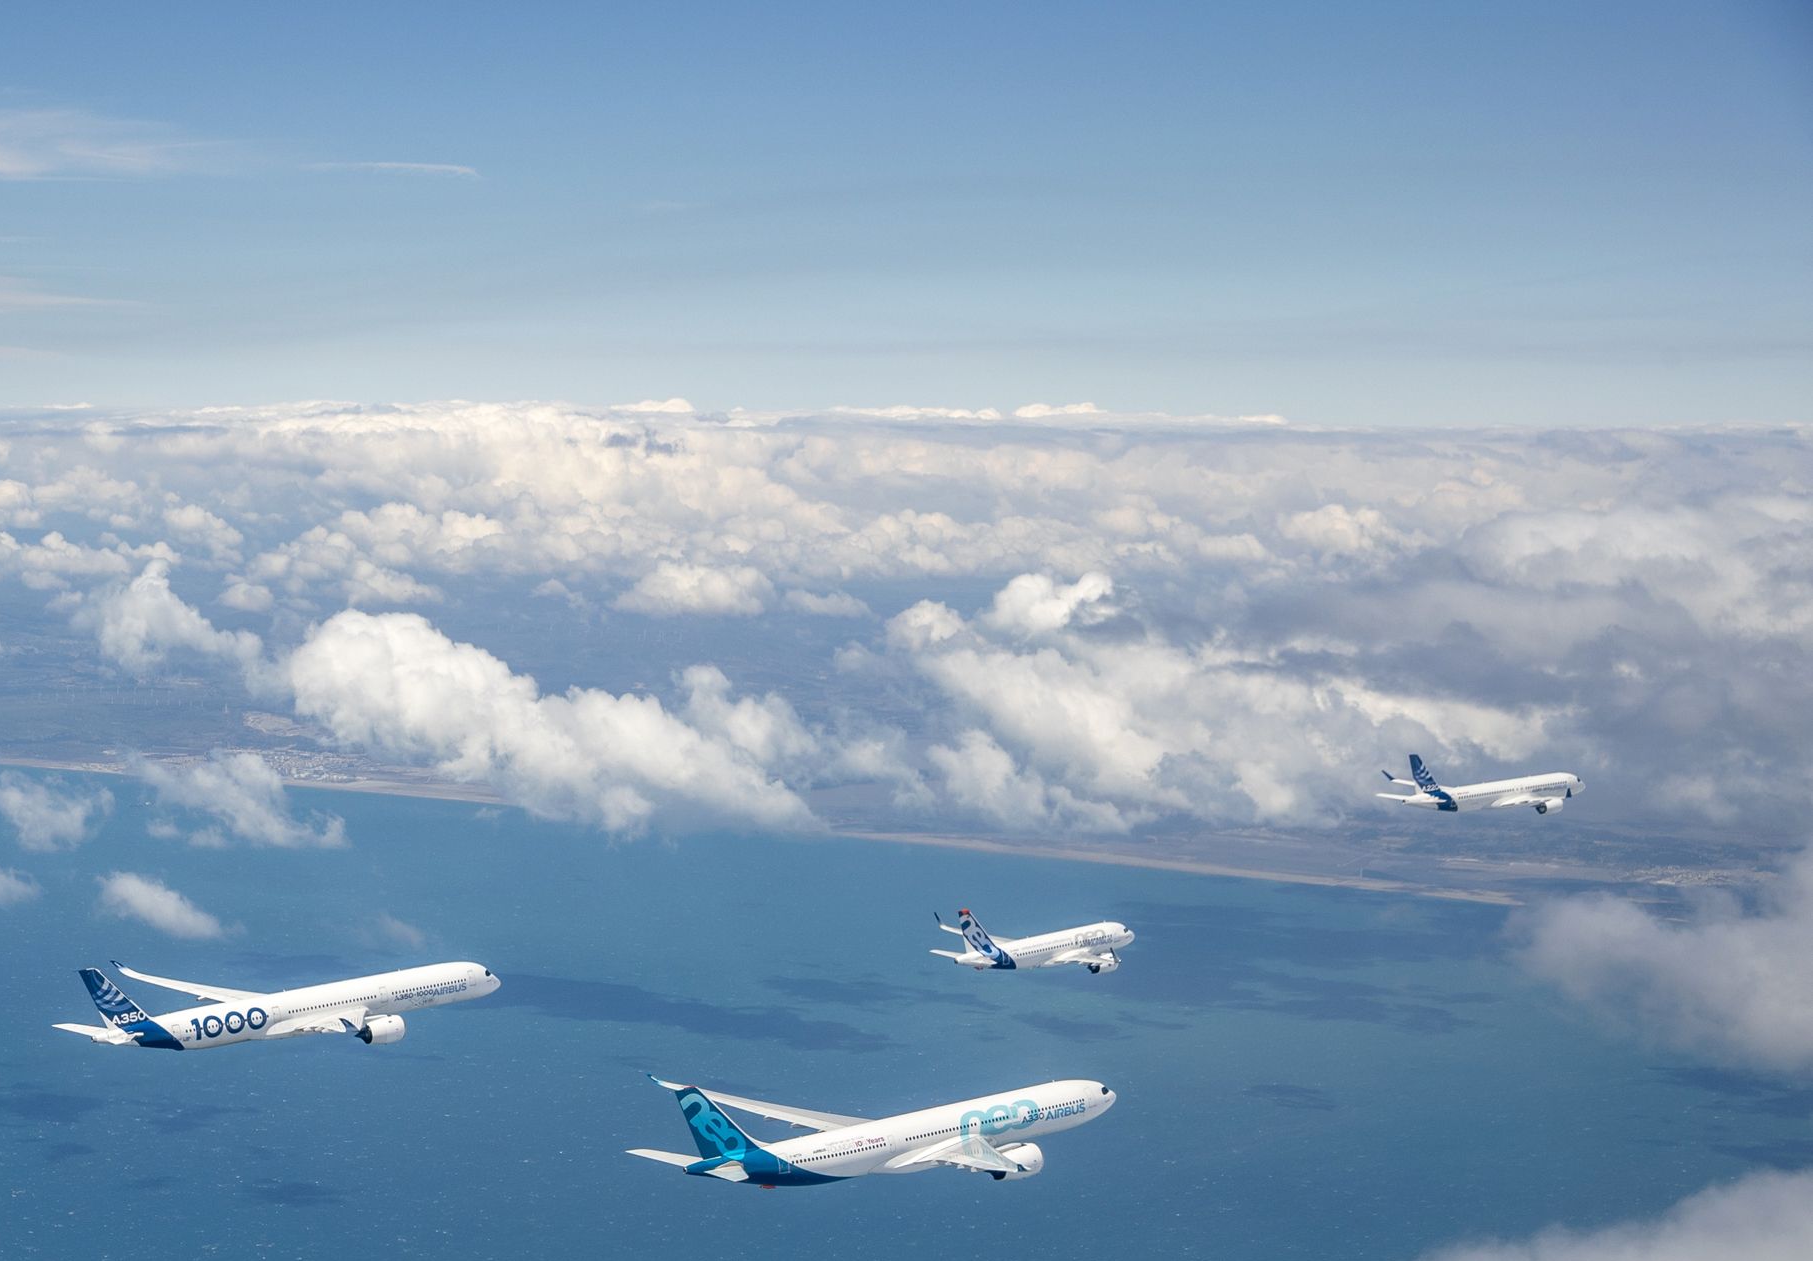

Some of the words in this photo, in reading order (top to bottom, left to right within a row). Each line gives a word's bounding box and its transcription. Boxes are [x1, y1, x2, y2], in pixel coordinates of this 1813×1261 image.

[433, 982, 467, 997] AIRBUS
[112, 1010, 148, 1025] A350
[191, 1007, 268, 1041] 1000
[1021, 1112, 1045, 1124] A330
[1045, 1103, 1086, 1121] AIRBUS
[680, 1093, 746, 1160] neo
